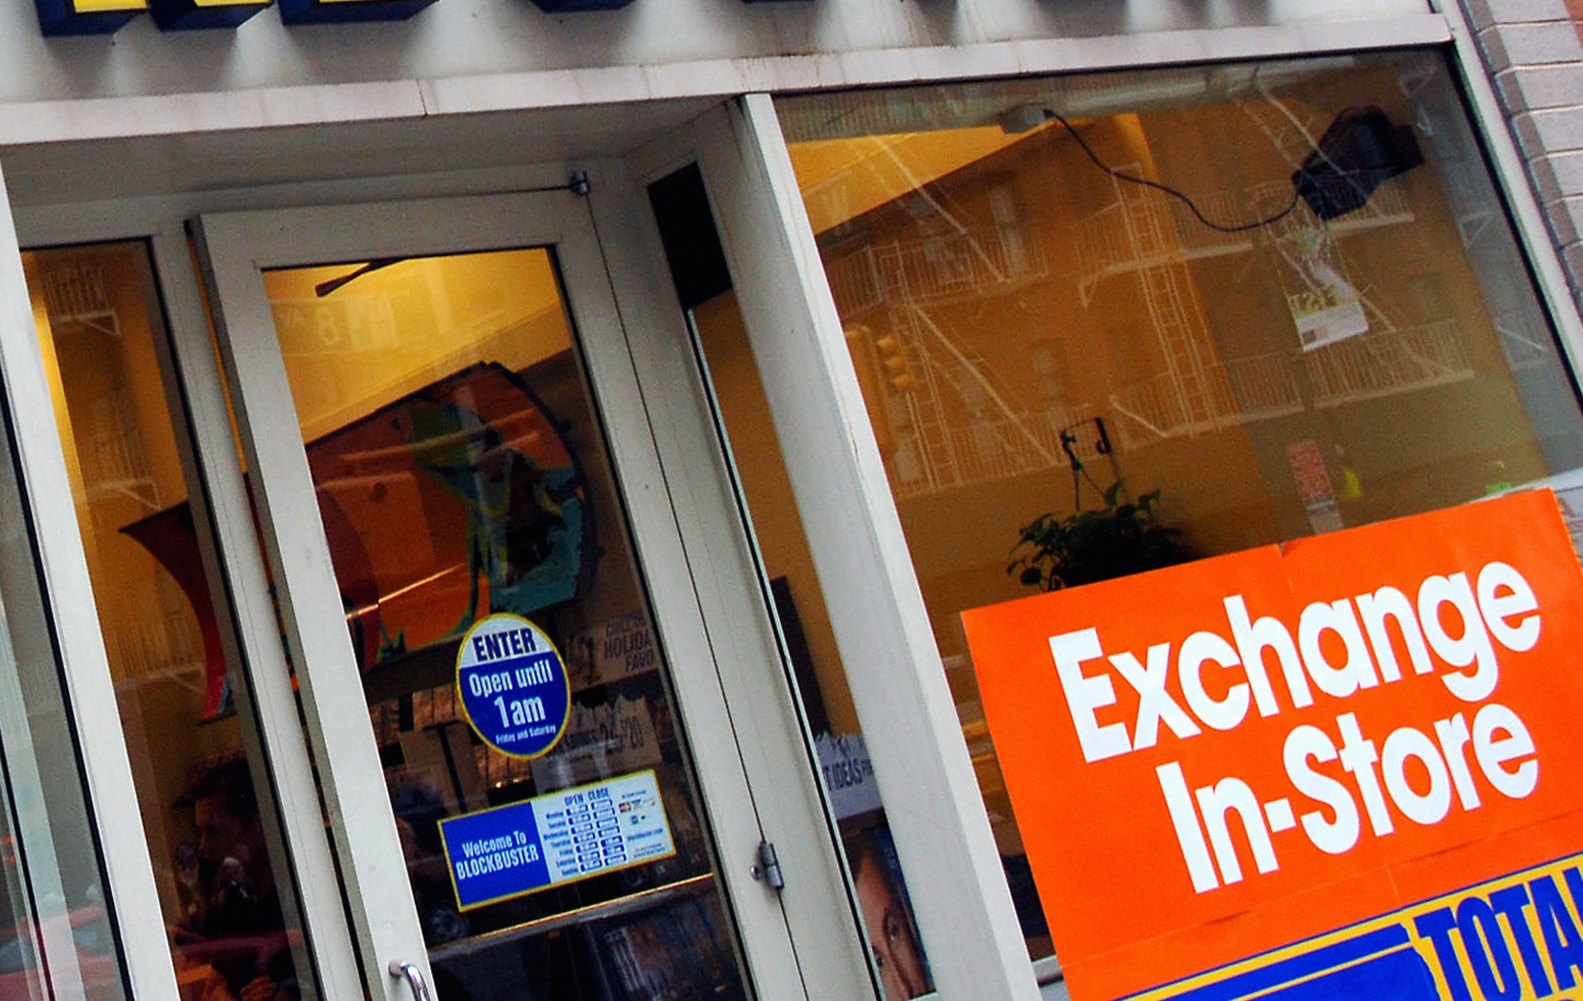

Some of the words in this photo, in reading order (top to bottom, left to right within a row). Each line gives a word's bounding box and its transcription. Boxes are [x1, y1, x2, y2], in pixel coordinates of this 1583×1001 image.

[472, 627, 537, 662] ENTER
[1049, 561, 1542, 763] Exchange
[469, 671, 513, 698] Open
[515, 659, 553, 689] until
[494, 696, 546, 728] 1am
[495, 733, 516, 744] Friday
[517, 730, 529, 741] and
[529, 723, 557, 739] Saturday
[587, 787, 609, 801] CLOSE
[1155, 703, 1539, 894] In-Store
[455, 844, 540, 880] BLOCKBUSTER
[462, 836, 513, 859] Welcome
[514, 830, 527, 847] To
